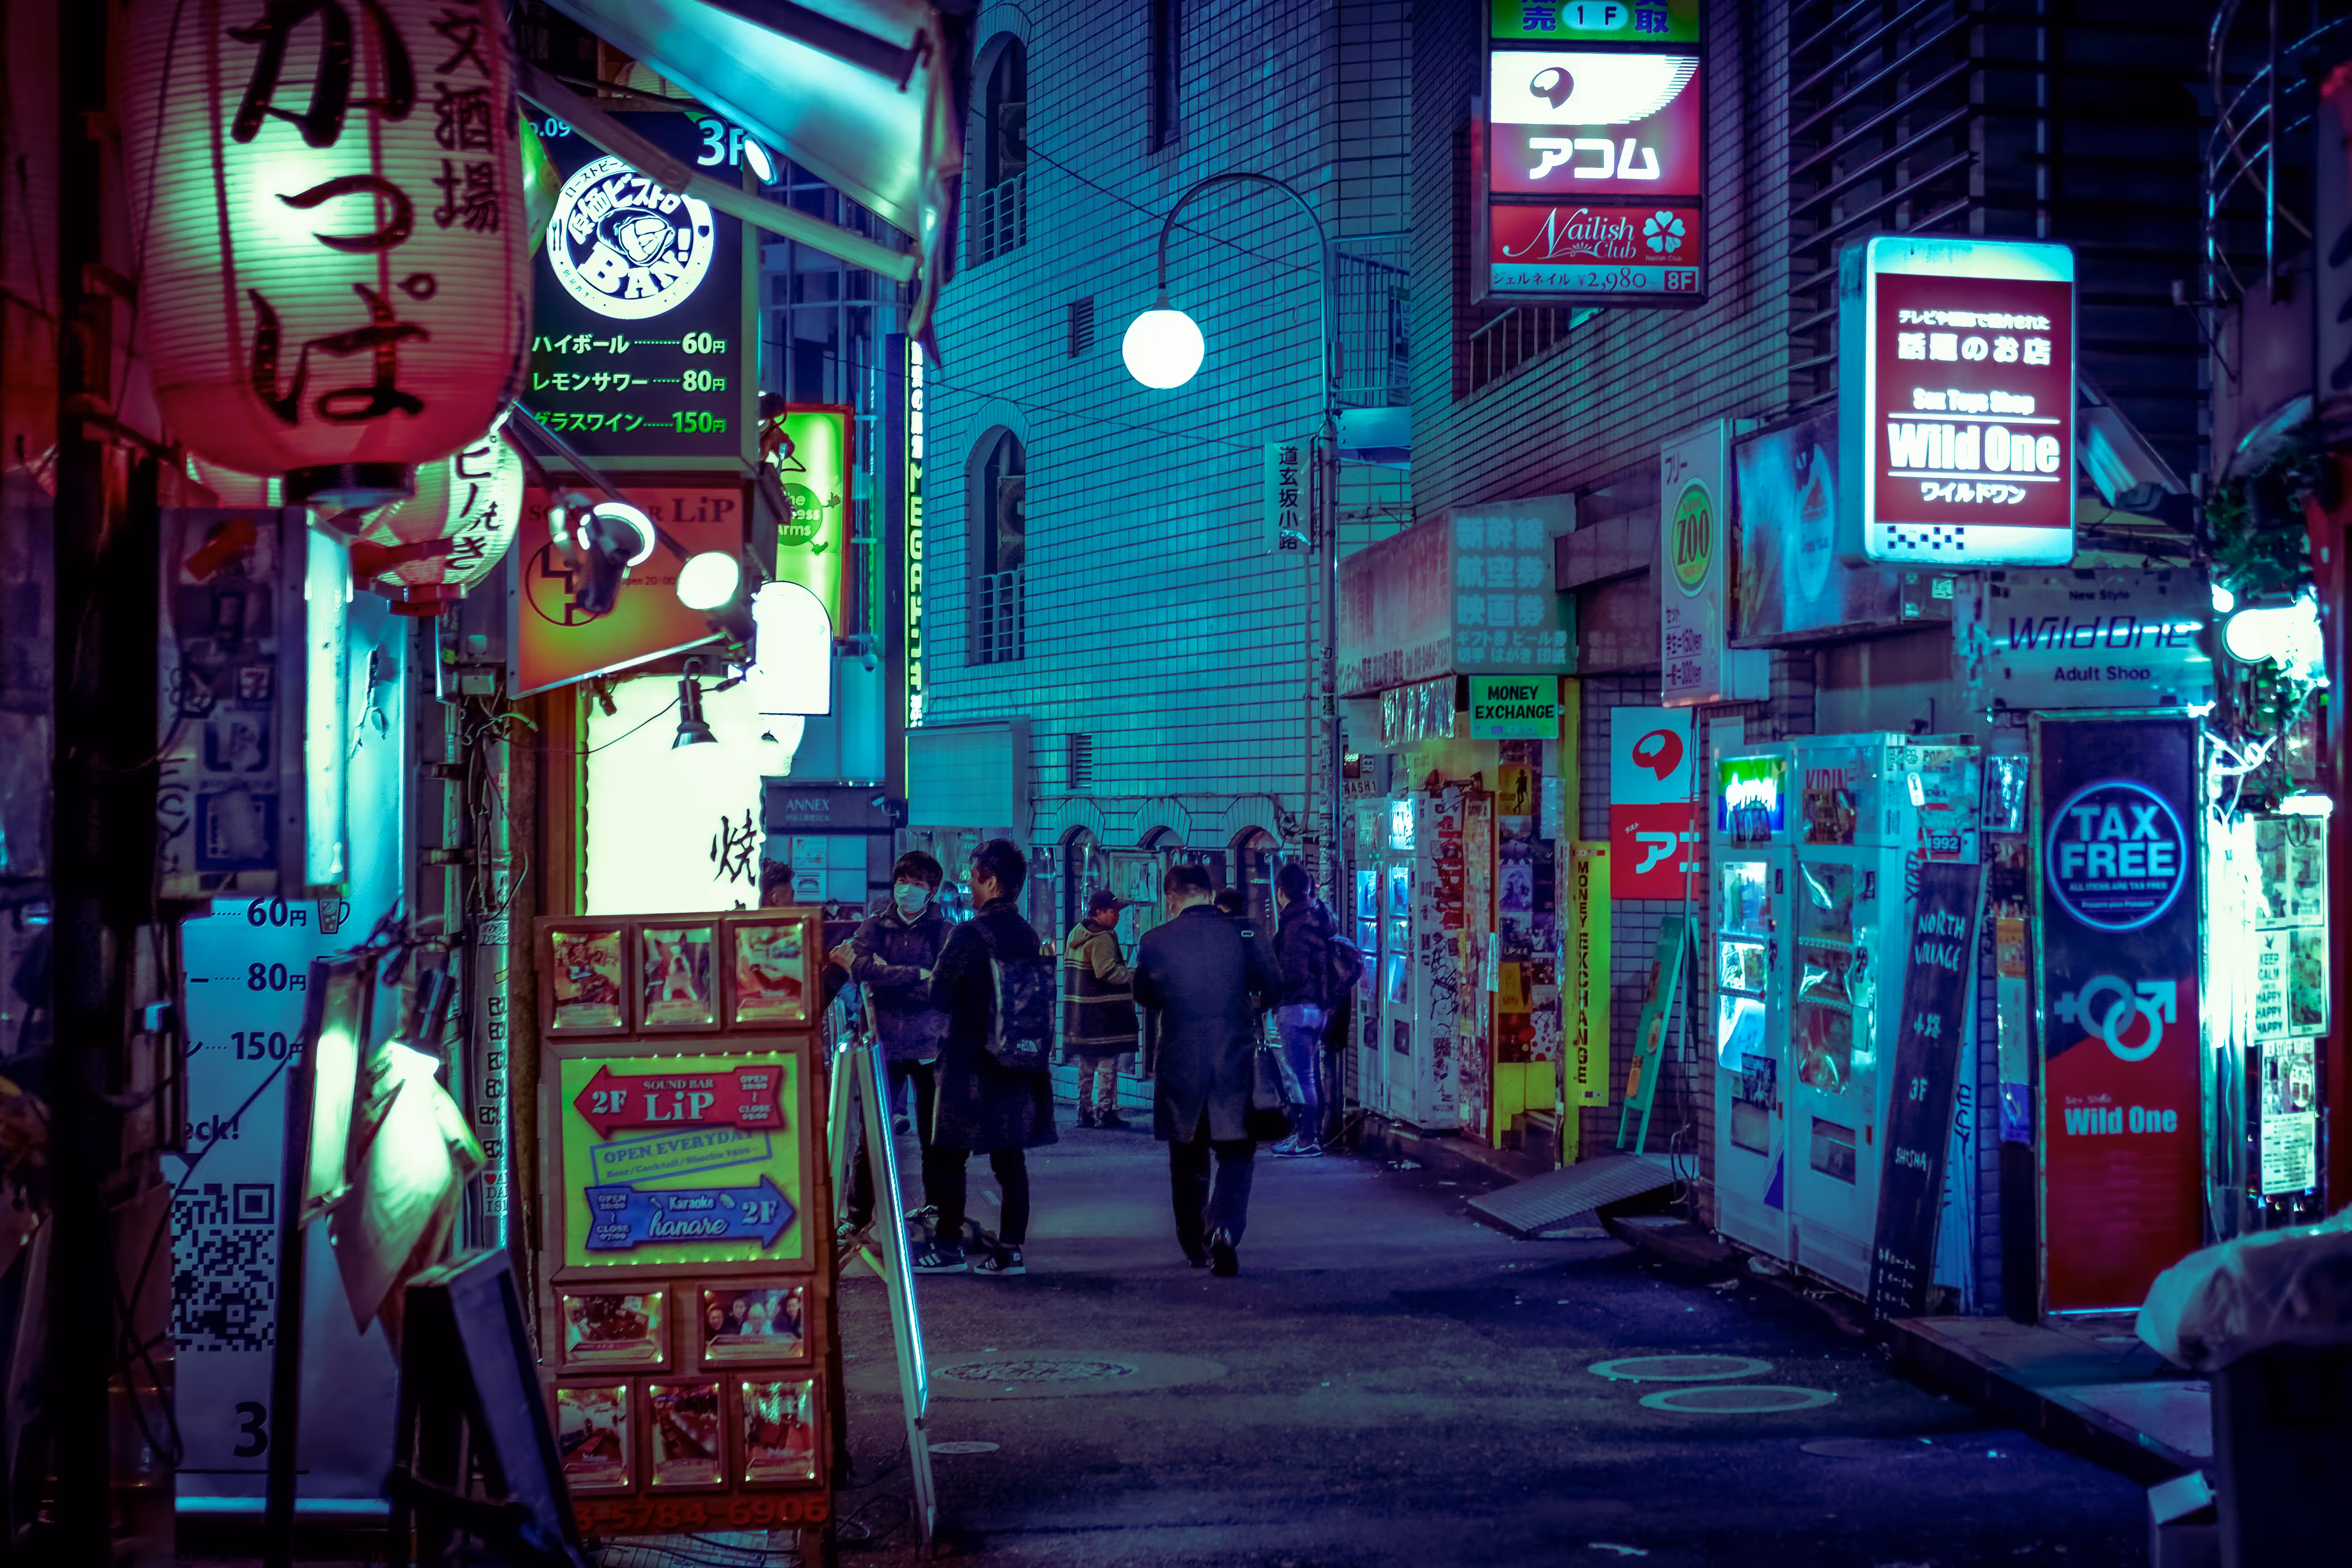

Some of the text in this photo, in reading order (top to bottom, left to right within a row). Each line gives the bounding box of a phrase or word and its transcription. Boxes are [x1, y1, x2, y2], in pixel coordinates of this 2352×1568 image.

[697, 120, 745, 166] 3F
[1529, 137, 1660, 180] アコム
[565, 160, 627, 198] ローストビー
[1502, 207, 1636, 259] Nailish Club
[1493, 271, 1570, 286] ジェルネイル
[1667, 272, 1693, 291] 8F
[532, 332, 727, 355] ハイボール 60円
[533, 370, 727, 392] レモンサワー 80円
[672, 411, 727, 433] 150円
[1888, 423, 2059, 473] Wild One
[1279, 446, 1298, 550] 道玄坂小路
[1921, 481, 2026, 504] ワイルドワン
[671, 496, 735, 523] LiP
[1456, 517, 1544, 549] 新幹線
[1456, 555, 1544, 588] 航空券
[2069, 590, 2130, 601] New Style
[1457, 594, 1546, 627] 映画券
[2008, 615, 2191, 650] Wild One
[2054, 665, 2151, 683] Adult Shop
[1487, 685, 1538, 700] MONEY
[1474, 705, 1555, 719] EXCHANGE
[786, 798, 830, 811] ANNEX
[2070, 805, 2161, 841] TAX
[2061, 841, 2176, 878] FREE
[247, 897, 307, 927] 60円
[1918, 909, 1966, 940] NORTH
[247, 962, 307, 992] 80円
[1578, 861, 1589, 1084] MONEY EXCHANGE
[231, 1031, 304, 1061] 150円
[643, 1079, 714, 1090] SOUND BAR
[740, 1075, 768, 1084] OPEN
[592, 1090, 627, 1114] 2F
[643, 1091, 715, 1122] LiP
[738, 1104, 772, 1113] CLOSE
[185, 1115, 239, 1140] eck!
[2064, 1106, 2178, 1135] Wild One
[604, 1145, 652, 1164] OPEN
[598, 1194, 627, 1202] OPEN
[669, 1195, 715, 1211] Karaoke
[649, 1210, 729, 1237] hanare
[742, 1200, 778, 1224] 2F
